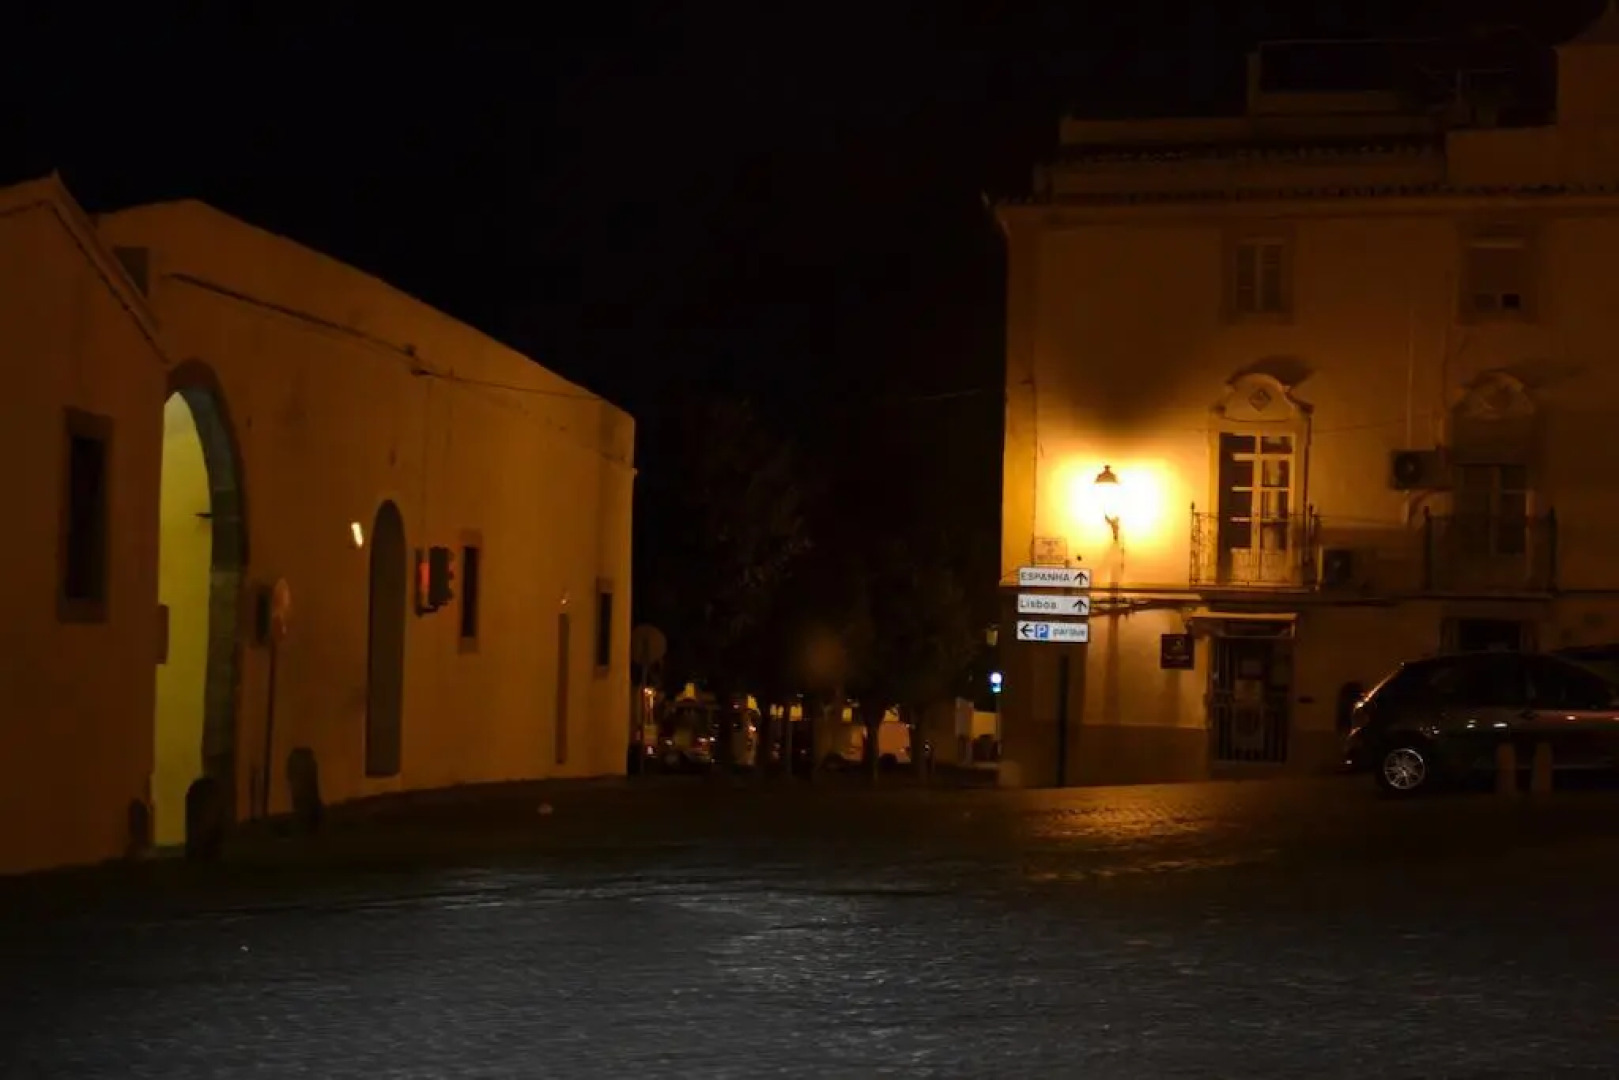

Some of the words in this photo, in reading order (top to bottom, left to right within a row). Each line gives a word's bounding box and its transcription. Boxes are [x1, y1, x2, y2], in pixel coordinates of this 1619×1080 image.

[1021, 571, 1070, 582] ESPANHA
[1020, 597, 1057, 609] Lisboa
[1052, 627, 1086, 638] parque
